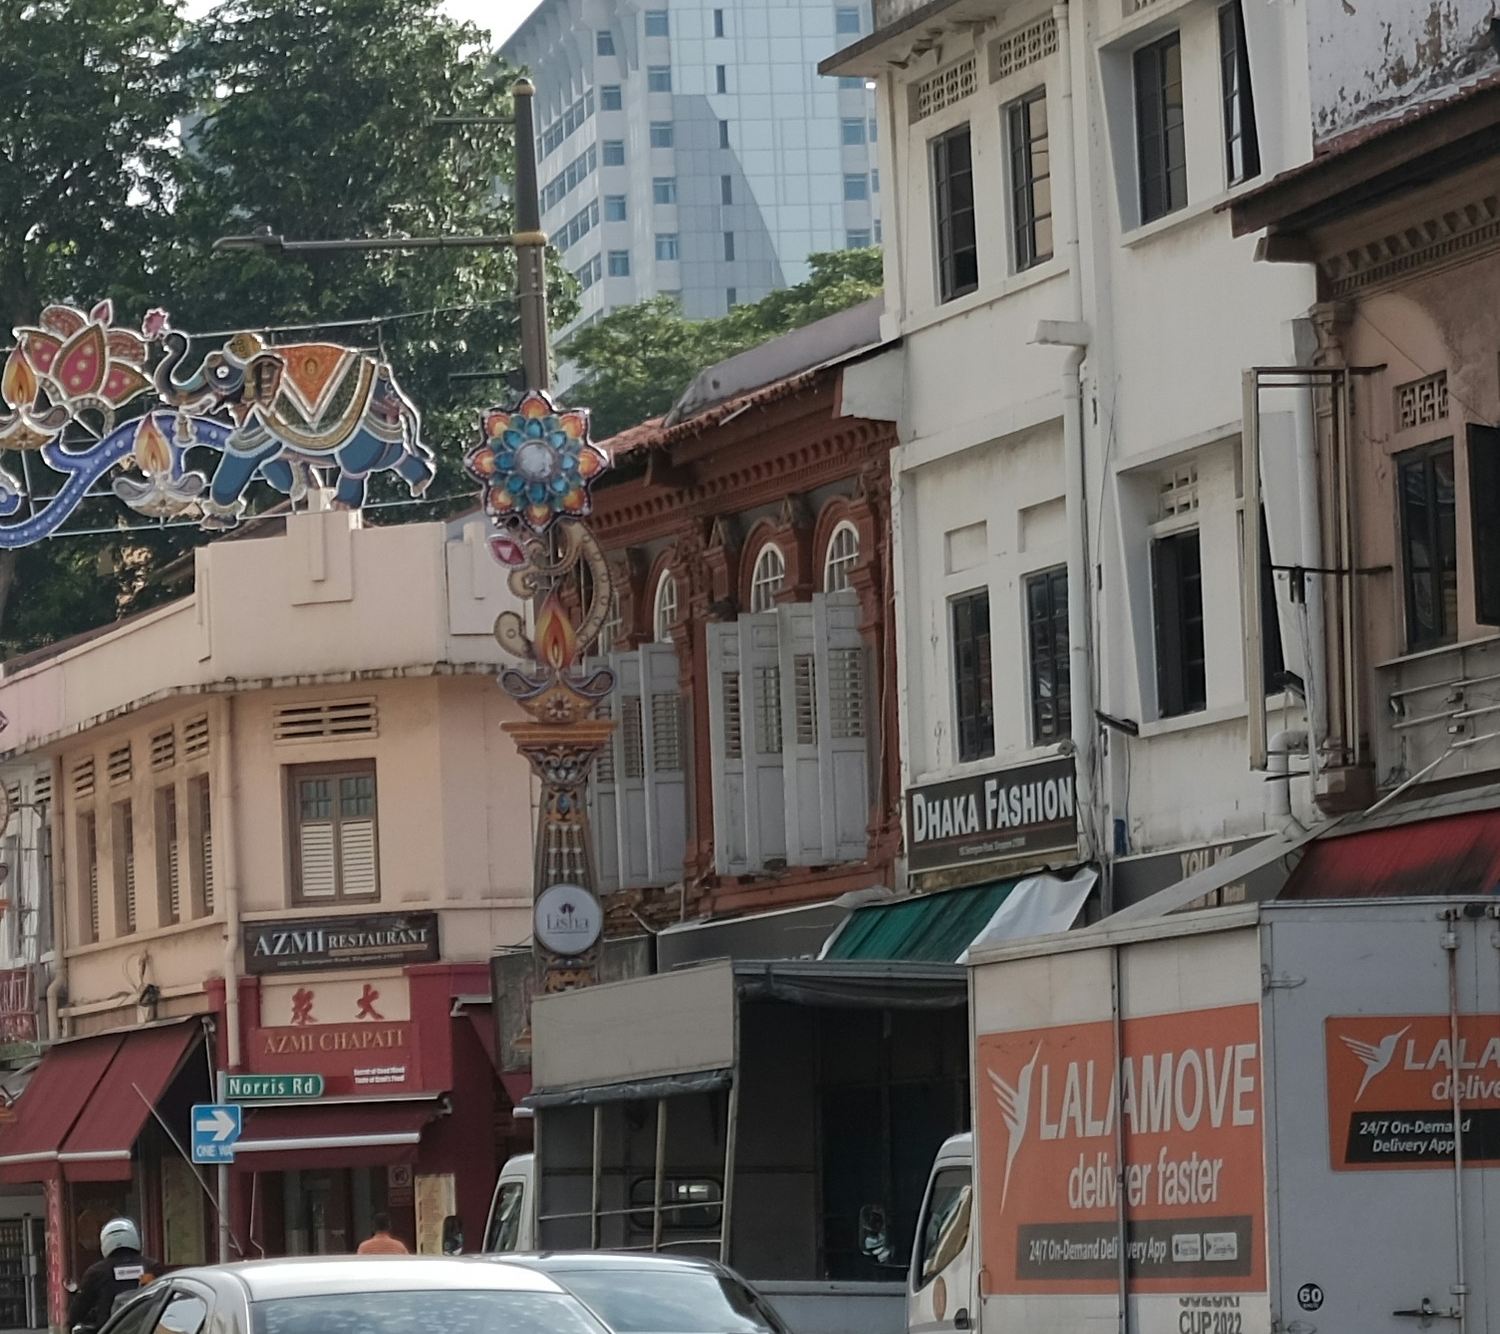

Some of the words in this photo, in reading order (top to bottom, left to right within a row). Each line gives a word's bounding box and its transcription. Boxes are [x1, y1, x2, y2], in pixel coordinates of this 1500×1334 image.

[912, 793, 980, 843] DHAKA
[984, 776, 1073, 831] FASHION
[253, 930, 325, 957] AZMI
[328, 929, 428, 949] RESTAURANT
[264, 1034, 314, 1054] AZMI
[319, 1029, 403, 1051] CHAPATI
[229, 1078, 286, 1095] Norris
[293, 1078, 313, 1095] Rd
[1039, 1043, 1256, 1140] LALAMOVE
[1359, 1120, 1388, 1135] 24/7
[1391, 1120, 1470, 1134] On-Demad
[196, 1146, 216, 1158] ONE
[217, 1145, 233, 1157] WA
[1373, 1139, 1427, 1155] Delivery
[1429, 1138, 1456, 1155] App
[1067, 1152, 1152, 1209] deliver
[1157, 1147, 1223, 1206] faster
[1029, 1240, 1049, 1265] 24/7
[1049, 1237, 1100, 1261] On-Demand
[1148, 1239, 1167, 1264] App
[1299, 1288, 1322, 1303] 60
